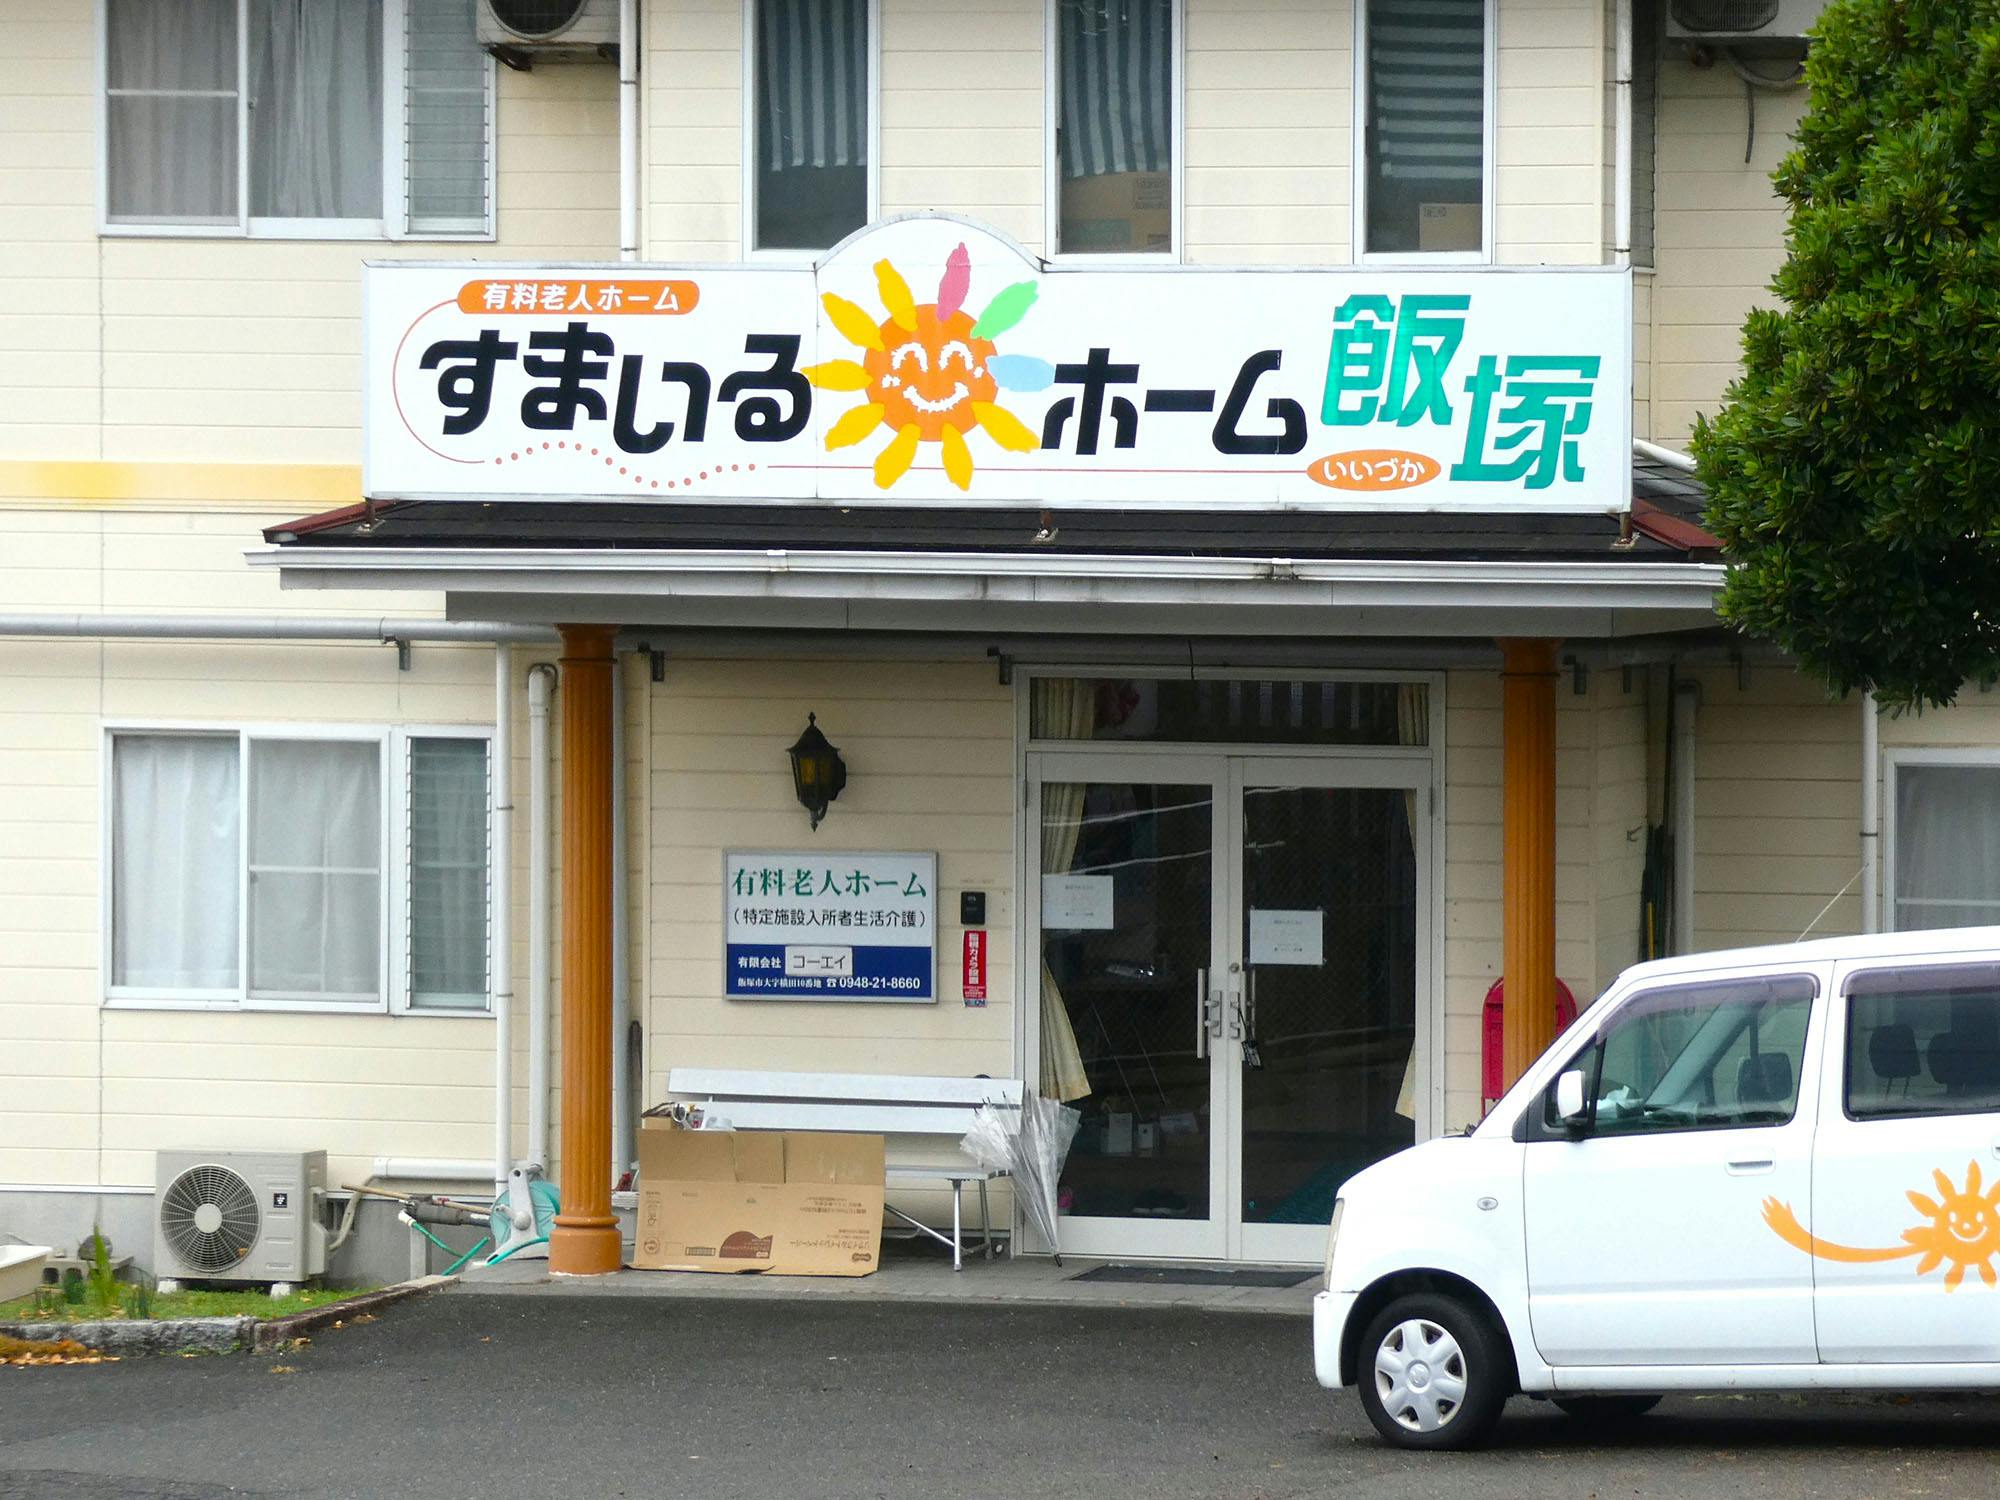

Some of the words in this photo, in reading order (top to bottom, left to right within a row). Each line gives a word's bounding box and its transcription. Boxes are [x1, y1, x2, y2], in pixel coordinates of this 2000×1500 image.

[483, 281, 680, 312] 有料老人ホーム
[419, 322, 812, 454] すまいる
[1041, 348, 1308, 455] ホーム
[1320, 294, 1601, 490] 飯塚
[1322, 458, 1426, 484] いいづか
[732, 868, 927, 898] 有料老人ホーム
[738, 956, 782, 969] 有限会社
[793, 955, 847, 970] コーエイ
[839, 976, 921, 990] 0948-21-8660
